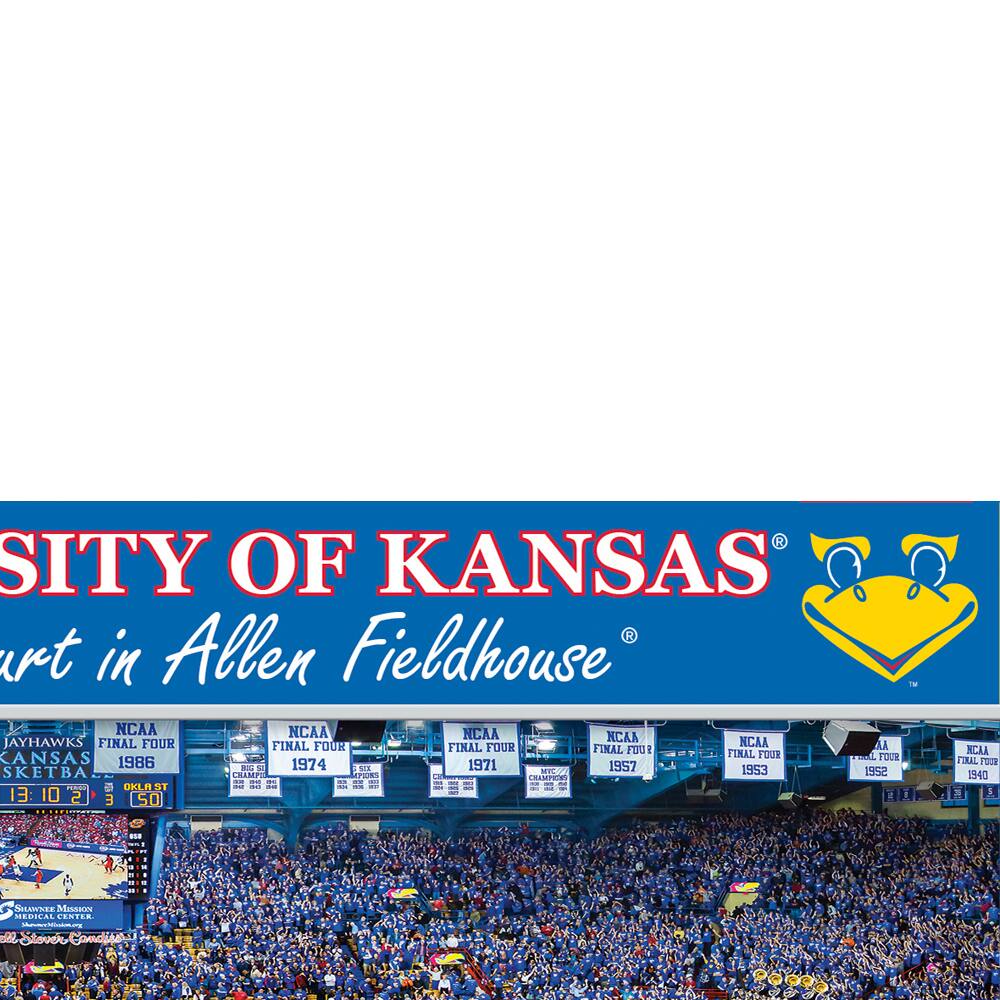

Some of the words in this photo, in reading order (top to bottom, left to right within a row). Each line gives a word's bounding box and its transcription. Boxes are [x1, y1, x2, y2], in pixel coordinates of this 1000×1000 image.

[228, 529, 355, 597] OF
[379, 529, 771, 597] KANSAS
[97, 629, 142, 682] in
[162, 611, 317, 685] Allen
[343, 611, 612, 683] Fieldhouse
[116, 722, 157, 736] NCAA
[288, 726, 328, 739] NCAA
[463, 727, 500, 740] NCAA
[3, 737, 83, 749] JAYHAWKS
[606, 731, 639, 743] NCAA
[739, 736, 769, 748] NCAA
[98, 738, 138, 749] FINAL
[141, 738, 175, 749] FOUR
[272, 741, 309, 751] FINAL
[314, 741, 346, 751] FOUR
[448, 742, 483, 753] FINAL
[486, 742, 515, 752] FOUR
[593, 744, 623, 755] FINAL
[728, 748, 756, 758] FINAL
[758, 749, 781, 759] FOUR
[966, 744, 989, 756] NCAA
[118, 755, 155, 769] 1986
[879, 752, 899, 761] FOUR
[957, 756, 978, 765] FINAL
[980, 757, 998, 766] FOUR
[292, 758, 327, 771] 1974
[468, 759, 497, 771] 1971
[609, 760, 637, 772] 1957
[742, 764, 768, 776] 1953
[865, 766, 888, 777] 1952
[968, 770, 988, 780] 1940
[123, 783, 151, 791] OKLA
[154, 783, 168, 791] ST
[71, 791, 81, 804] 2
[105, 794, 114, 806] 3
[137, 793, 160, 806] 50
[19, 931, 66, 945] Stover
